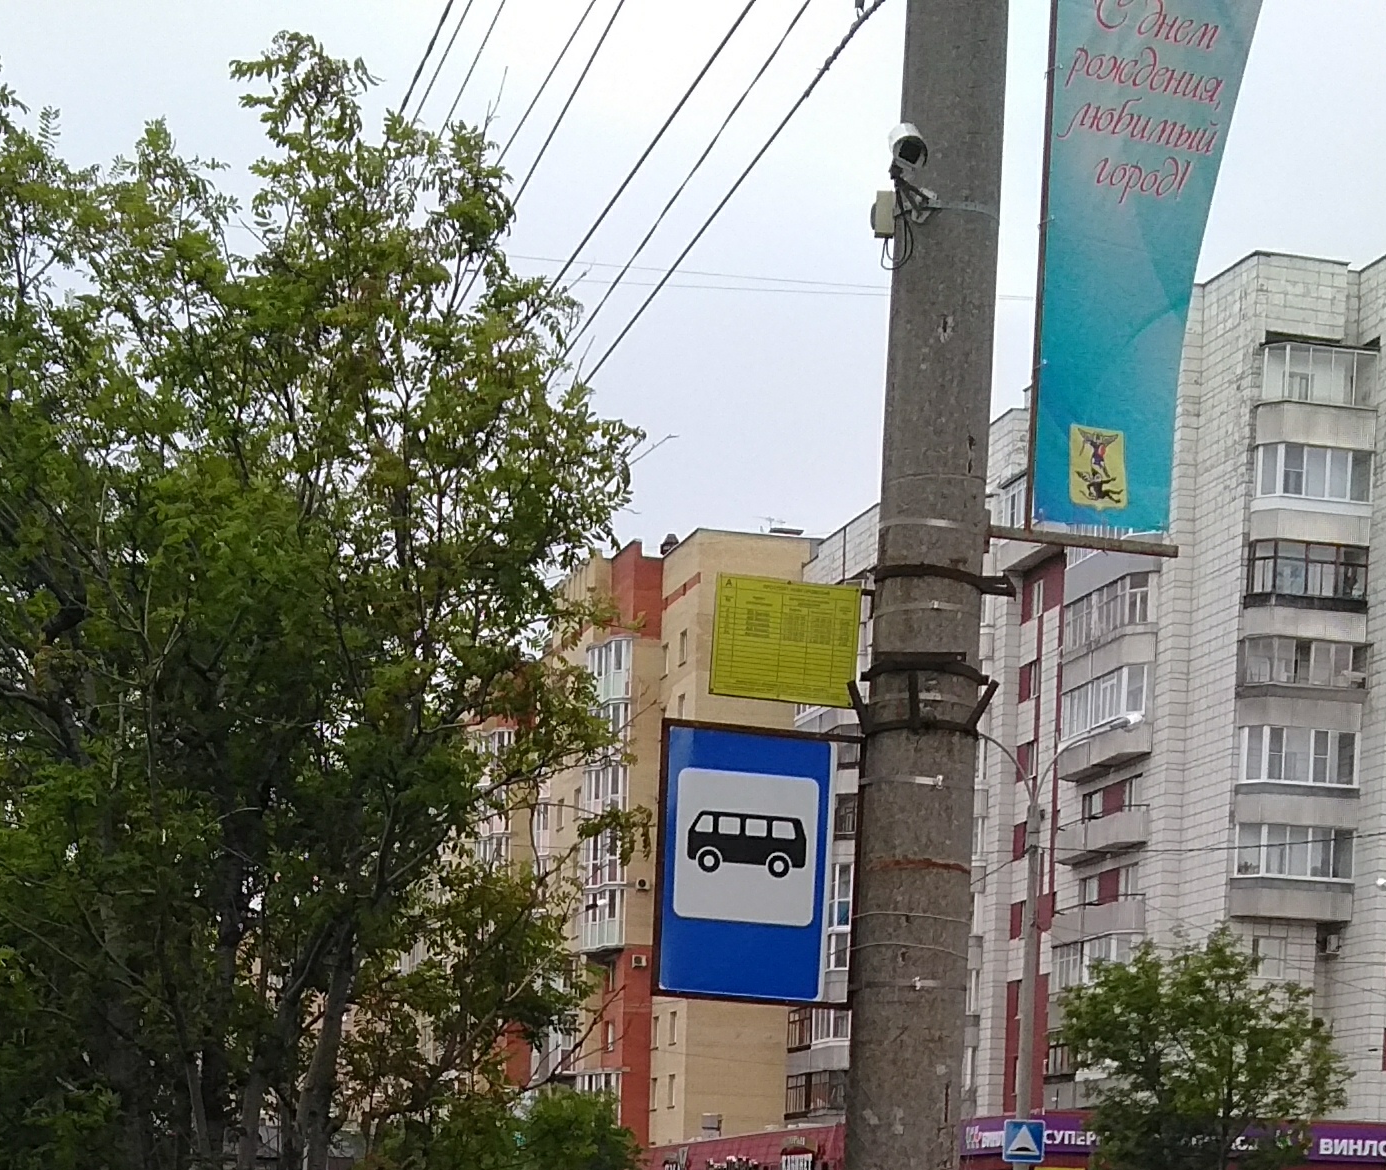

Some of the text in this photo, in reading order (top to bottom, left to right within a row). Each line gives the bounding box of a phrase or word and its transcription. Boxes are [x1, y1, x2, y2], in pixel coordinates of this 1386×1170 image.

[1137, 0, 1219, 50] днем
[1065, 45, 1224, 111] рождения,
[1056, 97, 1219, 155] любимый
[1094, 155, 1192, 204] город!
